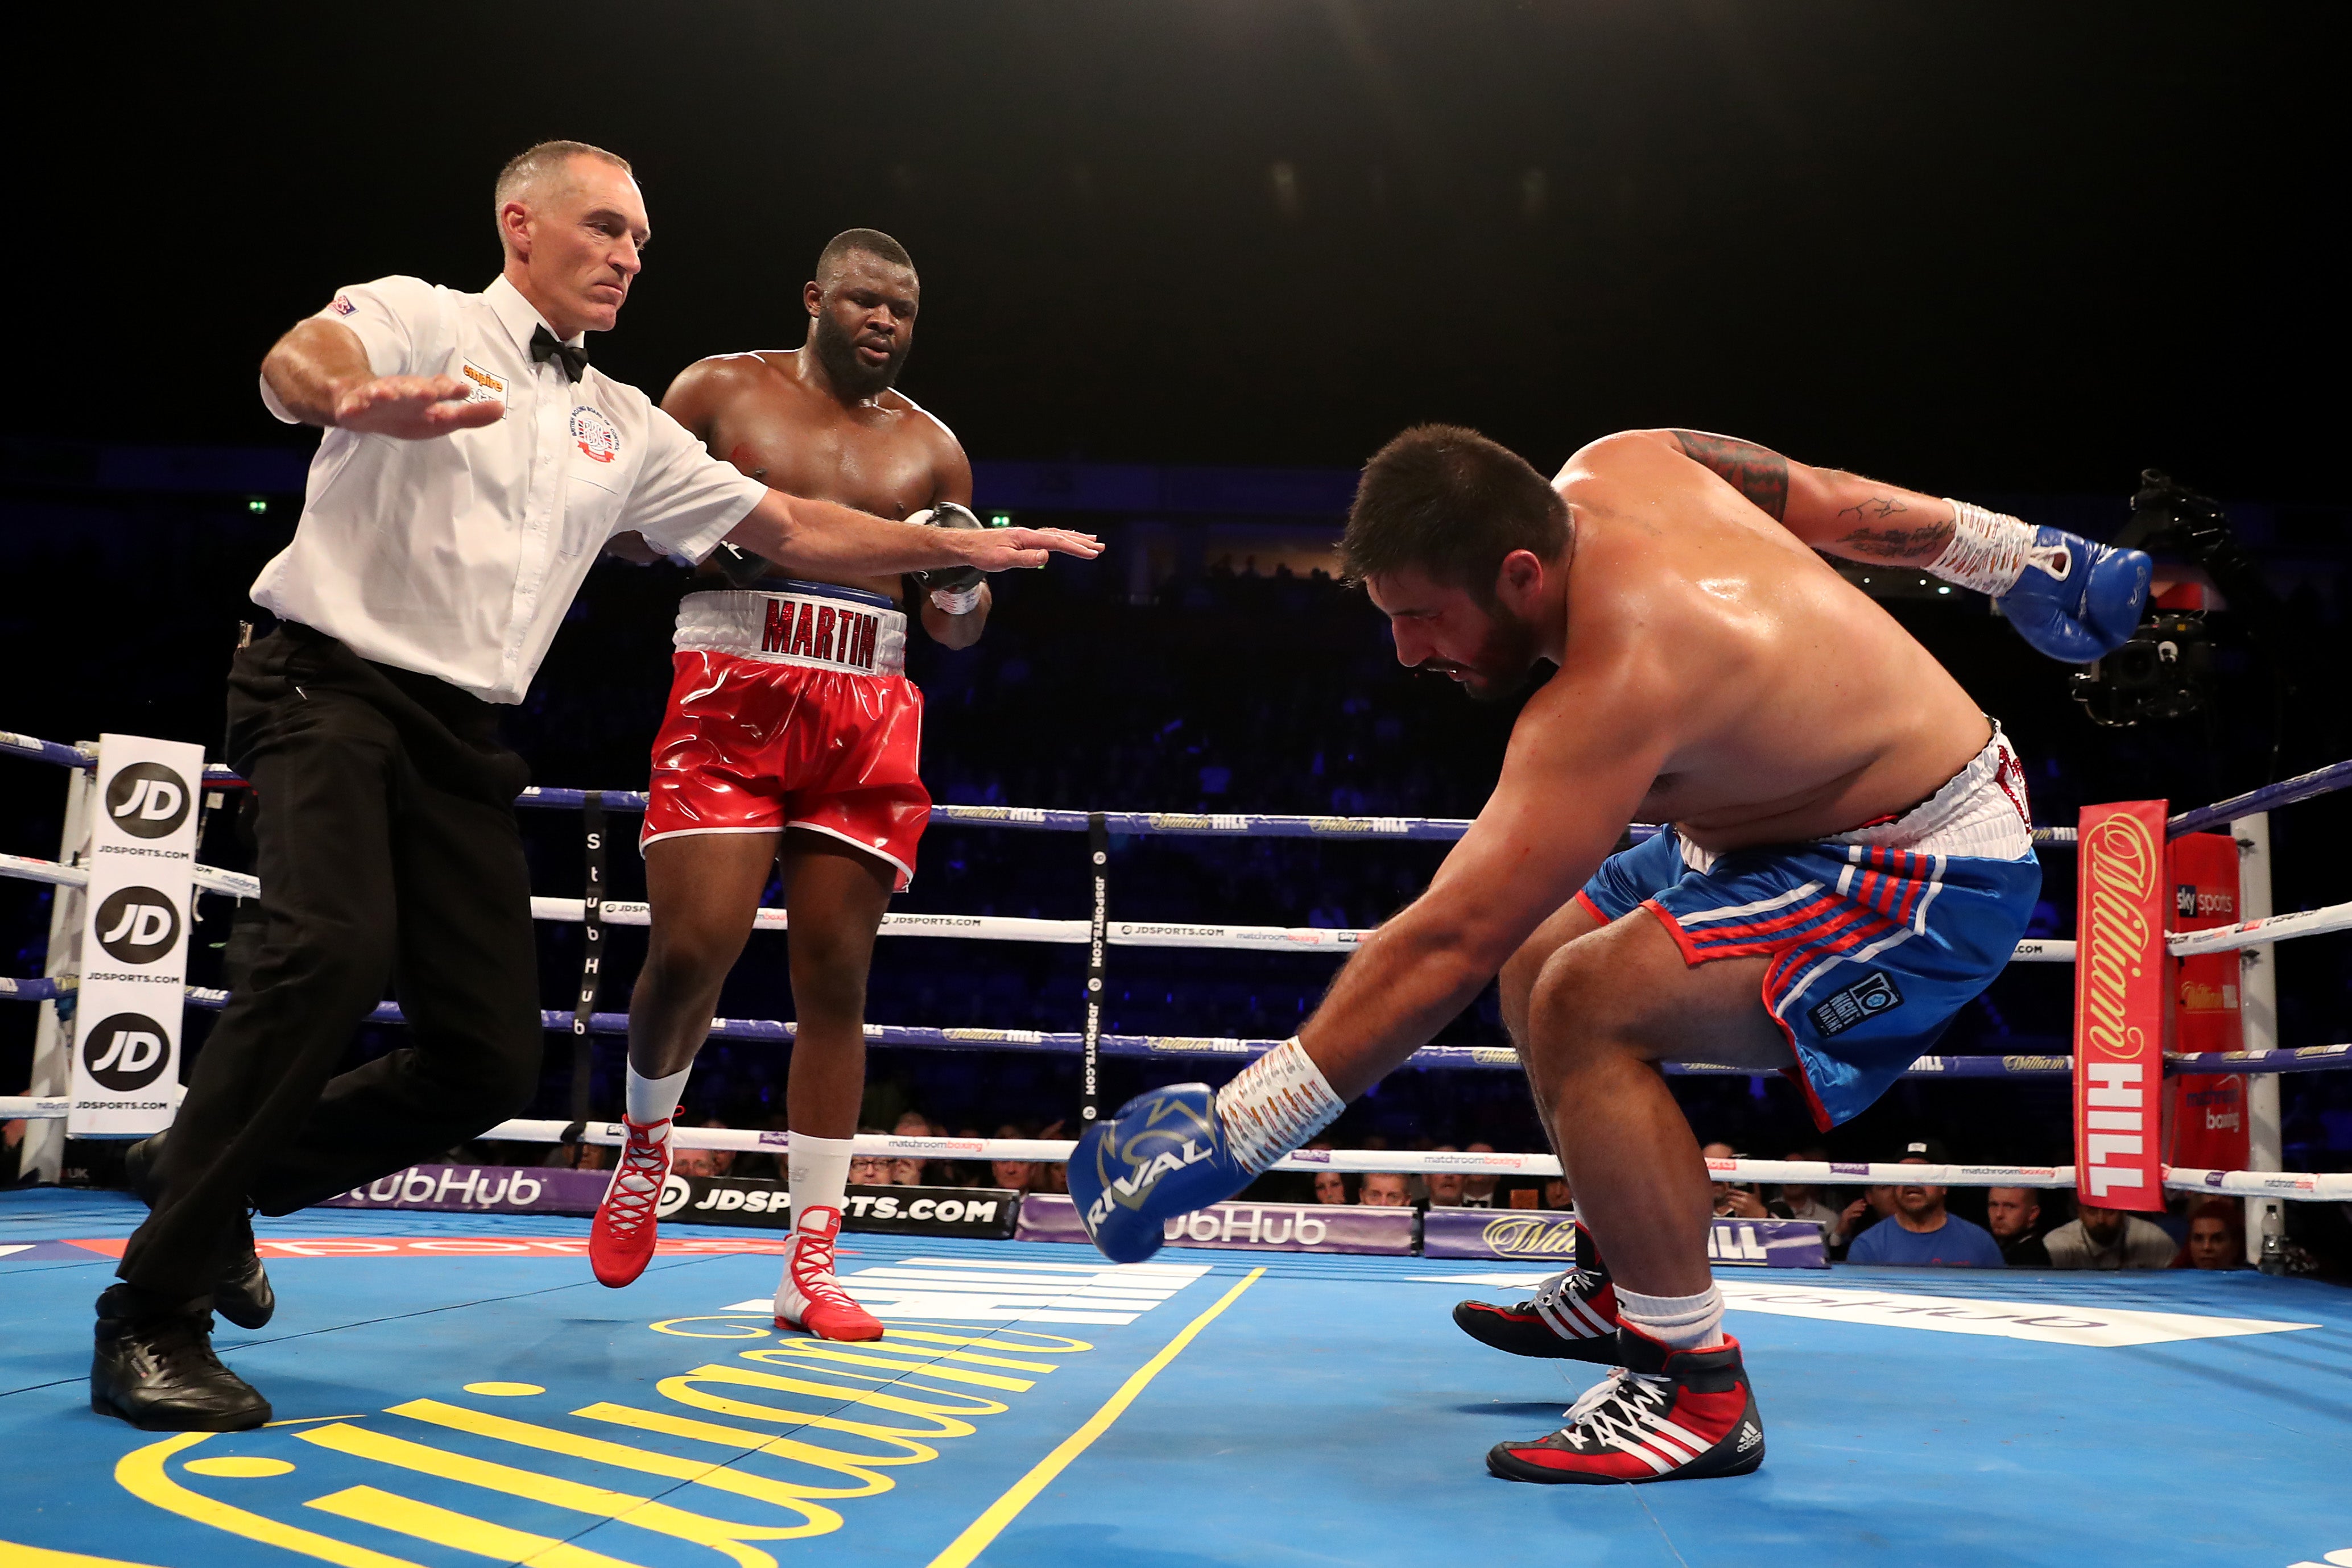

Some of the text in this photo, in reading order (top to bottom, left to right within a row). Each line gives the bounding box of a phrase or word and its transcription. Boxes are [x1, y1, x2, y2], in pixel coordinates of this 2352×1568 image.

[463, 365, 503, 392] empire
[761, 599, 879, 669] MARTIN
[114, 779, 183, 821] JD
[98, 846, 189, 859] JDSPORTS.COM
[2177, 887, 2196, 915] sky
[103, 904, 172, 946] JD
[572, 833, 601, 1035] StubHub
[892, 917, 982, 927] JDSPORTS.COM
[1091, 876, 1106, 968] JDSPORTS.COM
[1135, 926, 1225, 936] JDSPORTS.COM
[87, 972, 180, 984] JDSPORTS.COM
[1816, 1003, 1843, 1033] BOXING
[1829, 991, 1862, 1025] NIGHT
[2082, 812, 2156, 1197] William HILL
[92, 1031, 162, 1072] JD
[1084, 1003, 1099, 1095] JDSPORTS.COM
[2002, 1056, 2066, 1070] William
[76, 1101, 167, 1110] JDSPORTS.COM
[888, 1139, 983, 1152] matchroomboxing
[1424, 1155, 1522, 1168] matchroomboxing
[1962, 1168, 2056, 1178] matchroomboxing
[1086, 1139, 1213, 1238] RIVAL
[695, 1189, 998, 1223] JDSPTS.COM
[1737, 1432, 1763, 1453] adidas
